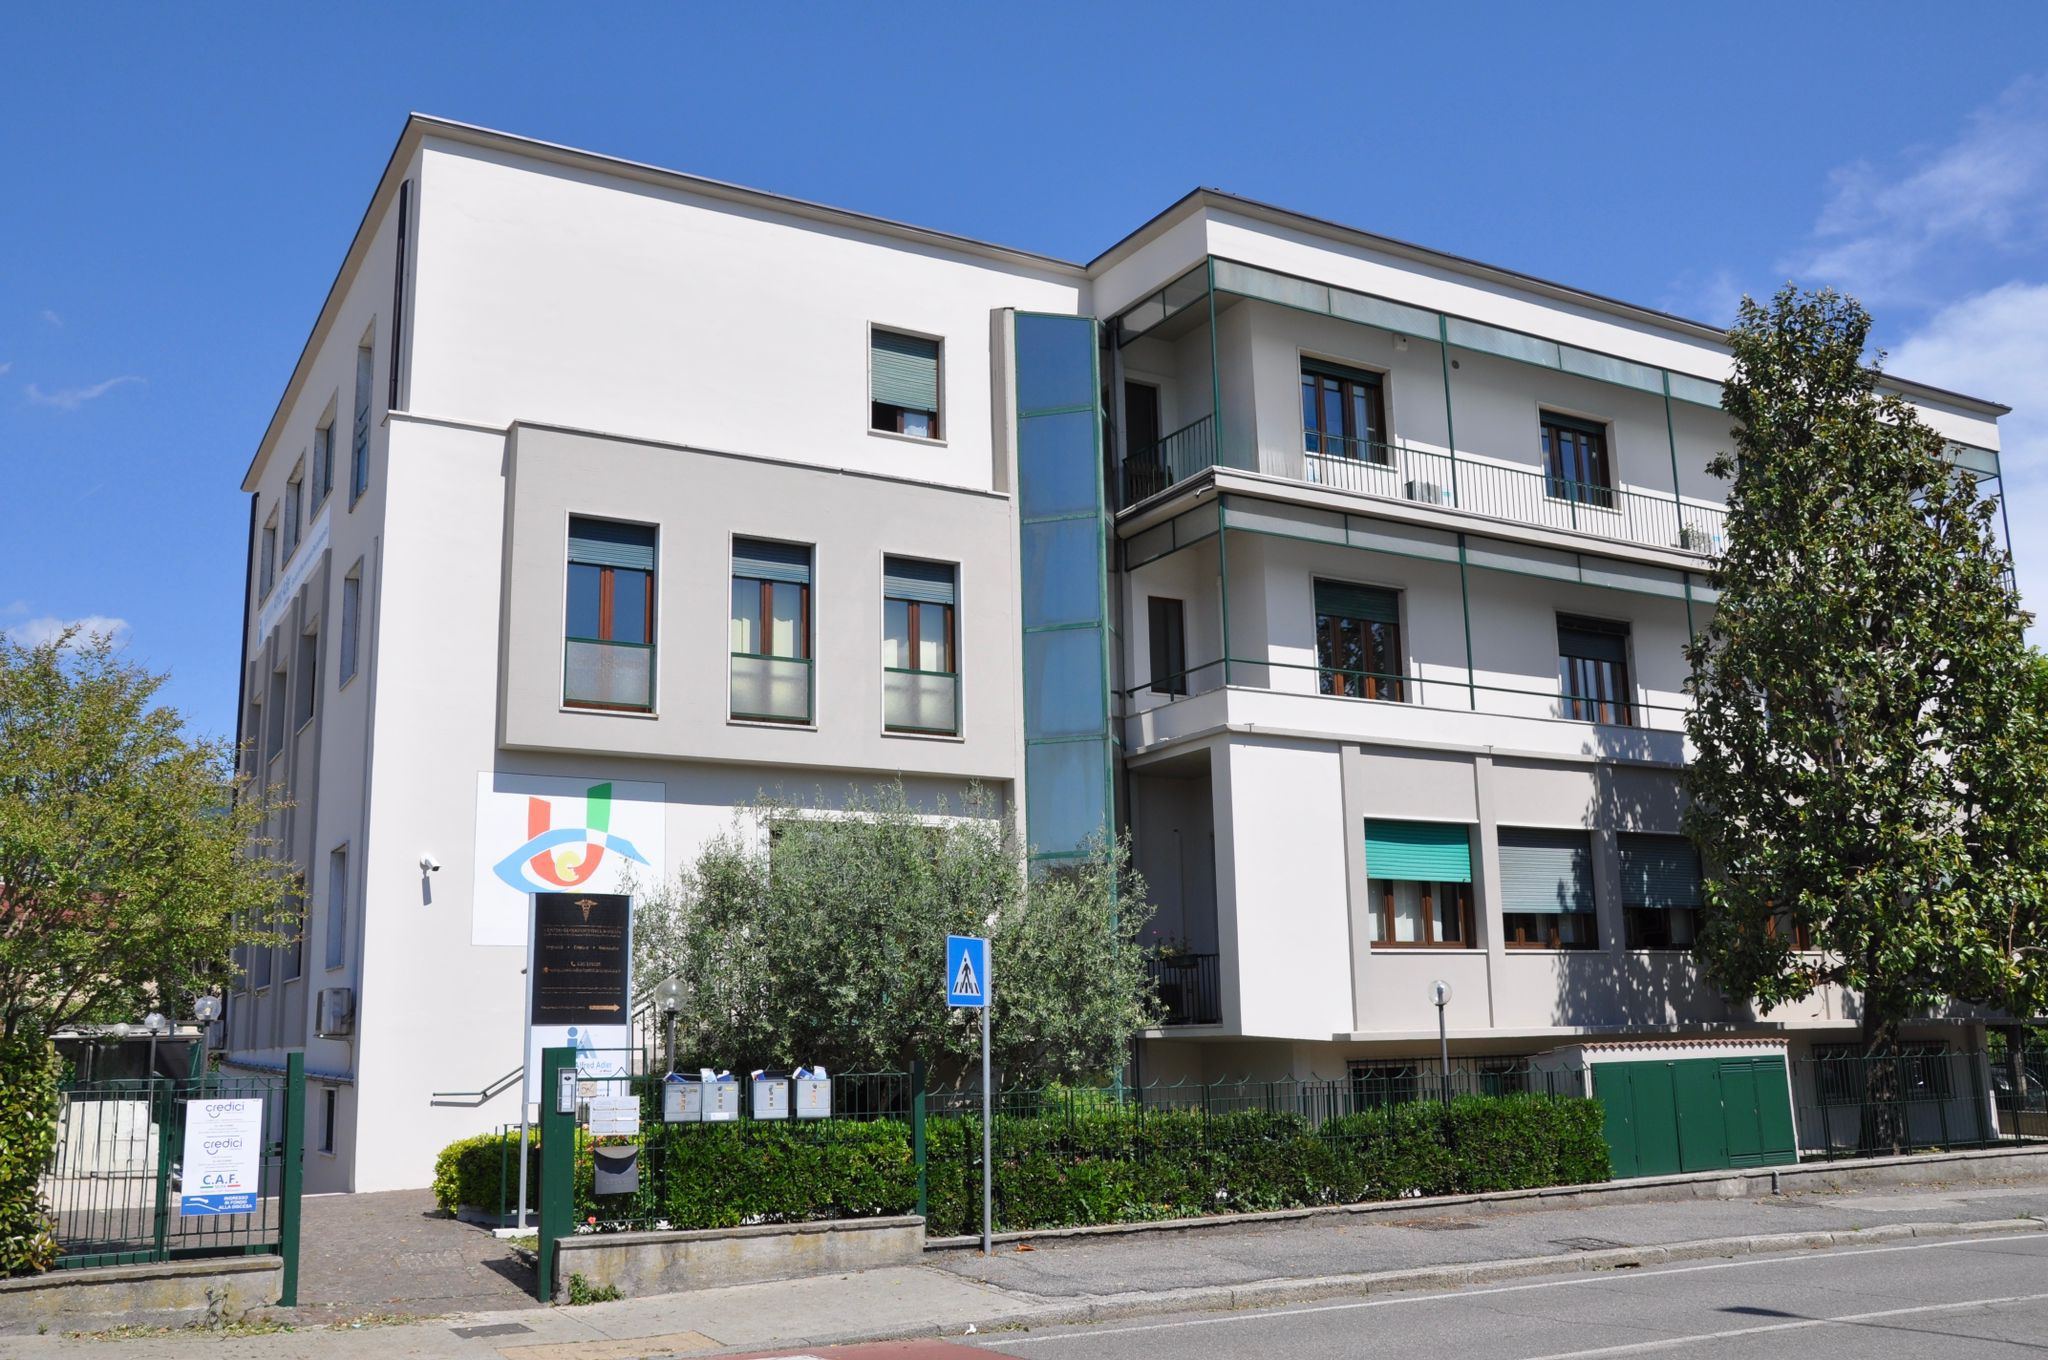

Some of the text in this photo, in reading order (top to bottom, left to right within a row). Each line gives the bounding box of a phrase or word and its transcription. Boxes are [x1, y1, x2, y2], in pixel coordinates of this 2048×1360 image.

[596, 1061, 613, 1069] Adler
[206, 1101, 245, 1112] credici
[203, 1138, 243, 1149] credici
[203, 1174, 239, 1185] C.A.F.
